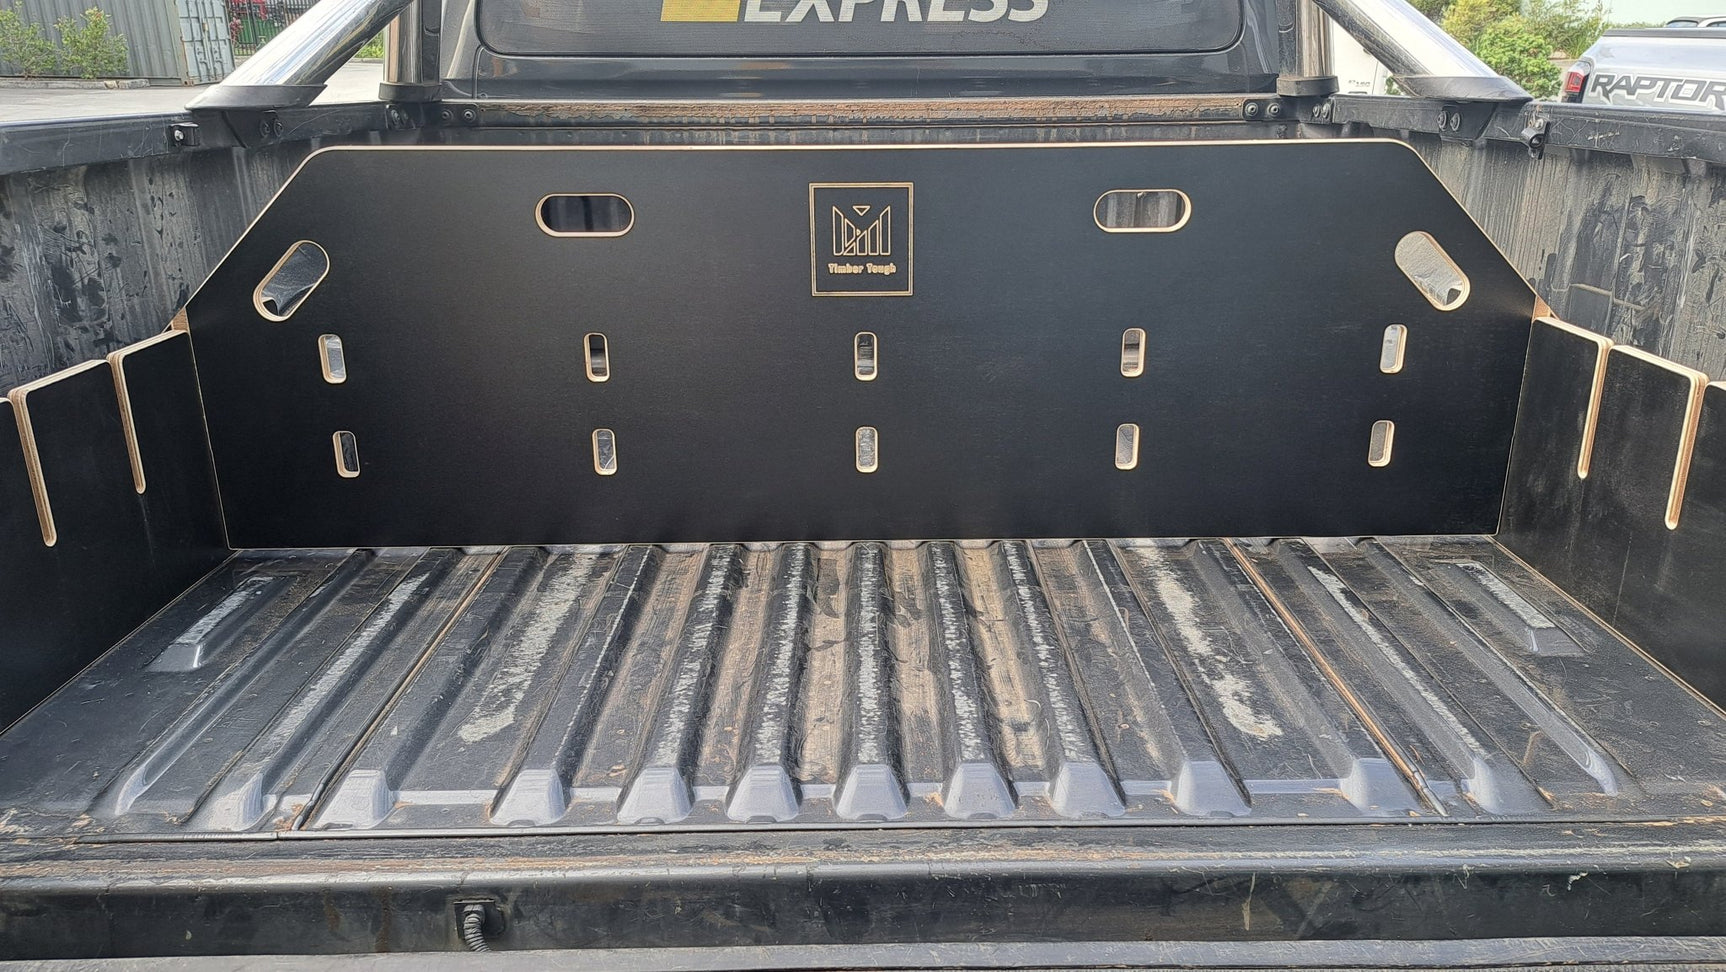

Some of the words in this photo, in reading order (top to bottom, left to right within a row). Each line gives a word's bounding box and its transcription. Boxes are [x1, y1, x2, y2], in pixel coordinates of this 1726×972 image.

[1590, 72, 1726, 111] RAPTOR
[827, 262, 864, 274] Timber
[866, 262, 897, 276] Tough
